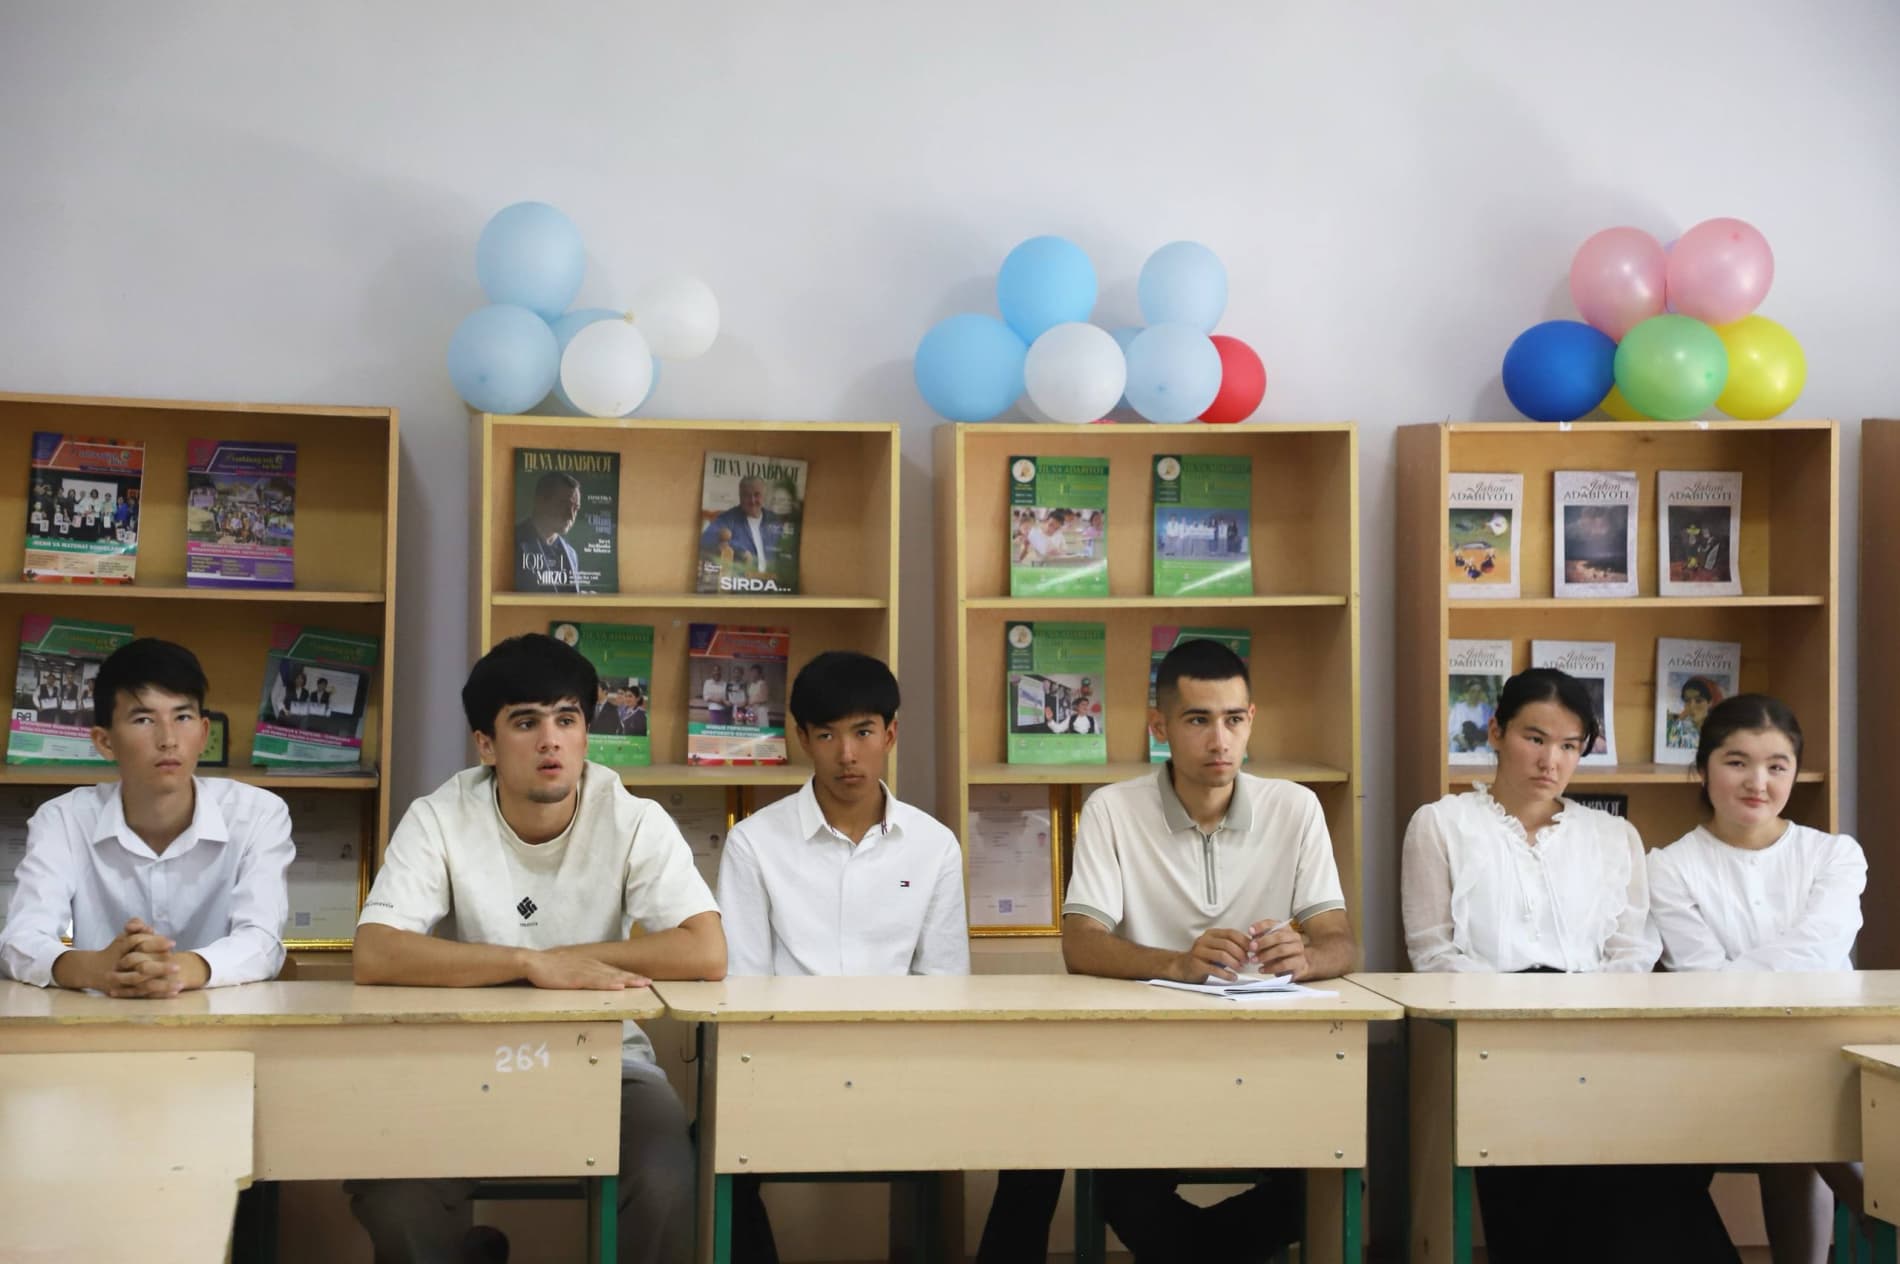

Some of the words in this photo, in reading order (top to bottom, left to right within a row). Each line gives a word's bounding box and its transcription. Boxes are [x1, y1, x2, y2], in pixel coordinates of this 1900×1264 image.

[1450, 492, 1513, 501] ADABIYOTI
[1564, 490, 1629, 499] ADABIYOTI
[1669, 491, 1732, 500] ADABIYOTI
[1449, 658, 1504, 667] DABIYOTI
[495, 1042, 550, 1073] 264
